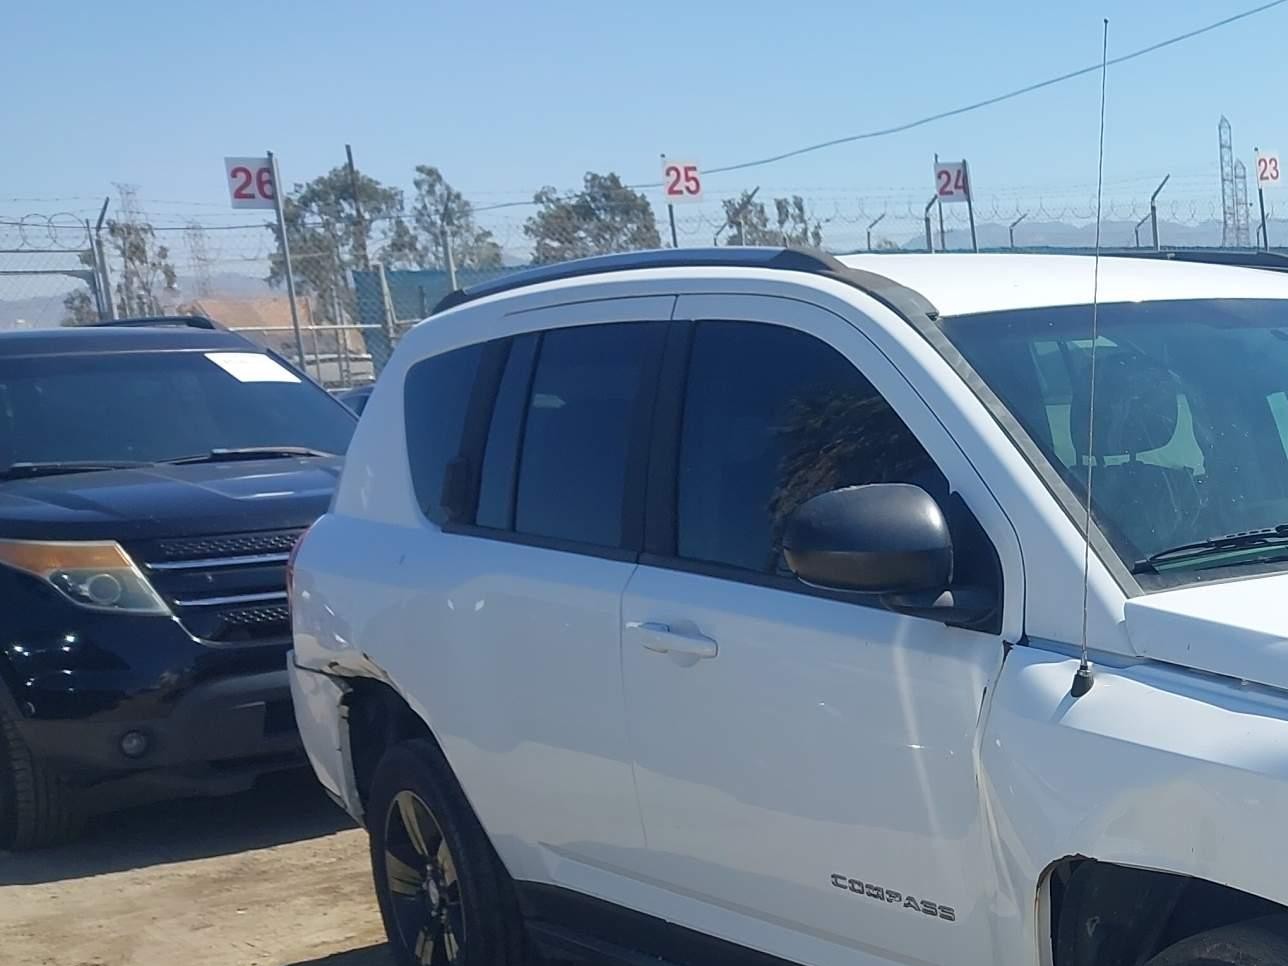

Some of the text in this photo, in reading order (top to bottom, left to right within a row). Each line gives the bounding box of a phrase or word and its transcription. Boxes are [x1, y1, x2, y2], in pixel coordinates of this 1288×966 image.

[230, 166, 275, 201] 26
[665, 165, 701, 196] 25
[937, 169, 969, 196] 24
[1258, 157, 1279, 181] 23
[830, 873, 956, 922] COMPASS
